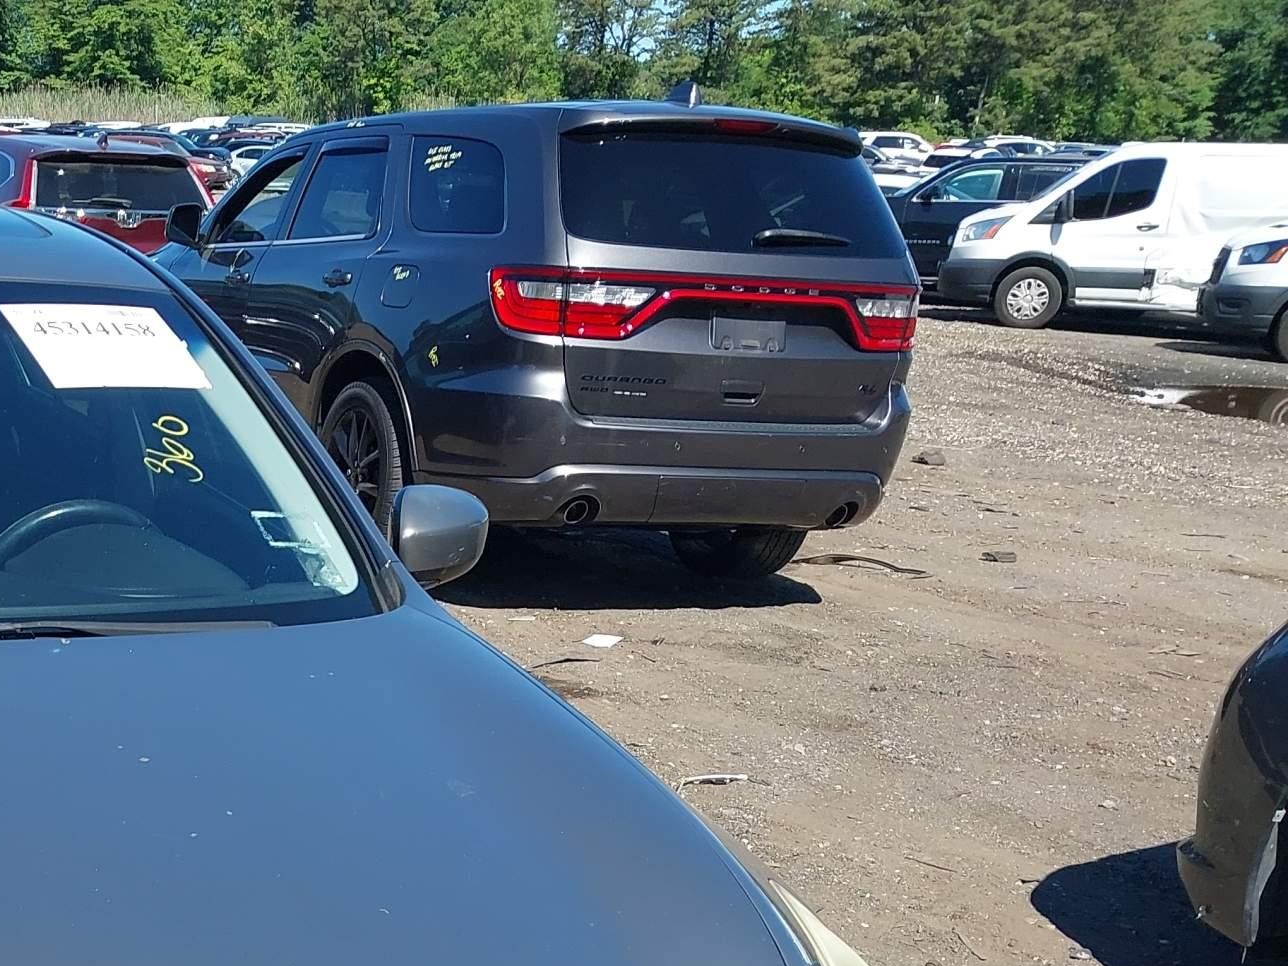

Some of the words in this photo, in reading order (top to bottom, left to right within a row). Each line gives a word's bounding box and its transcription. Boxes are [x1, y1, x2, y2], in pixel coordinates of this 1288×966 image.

[704, 283, 820, 296] DODGE
[33, 321, 156, 337] 45314158
[580, 375, 667, 385] DURANGO
